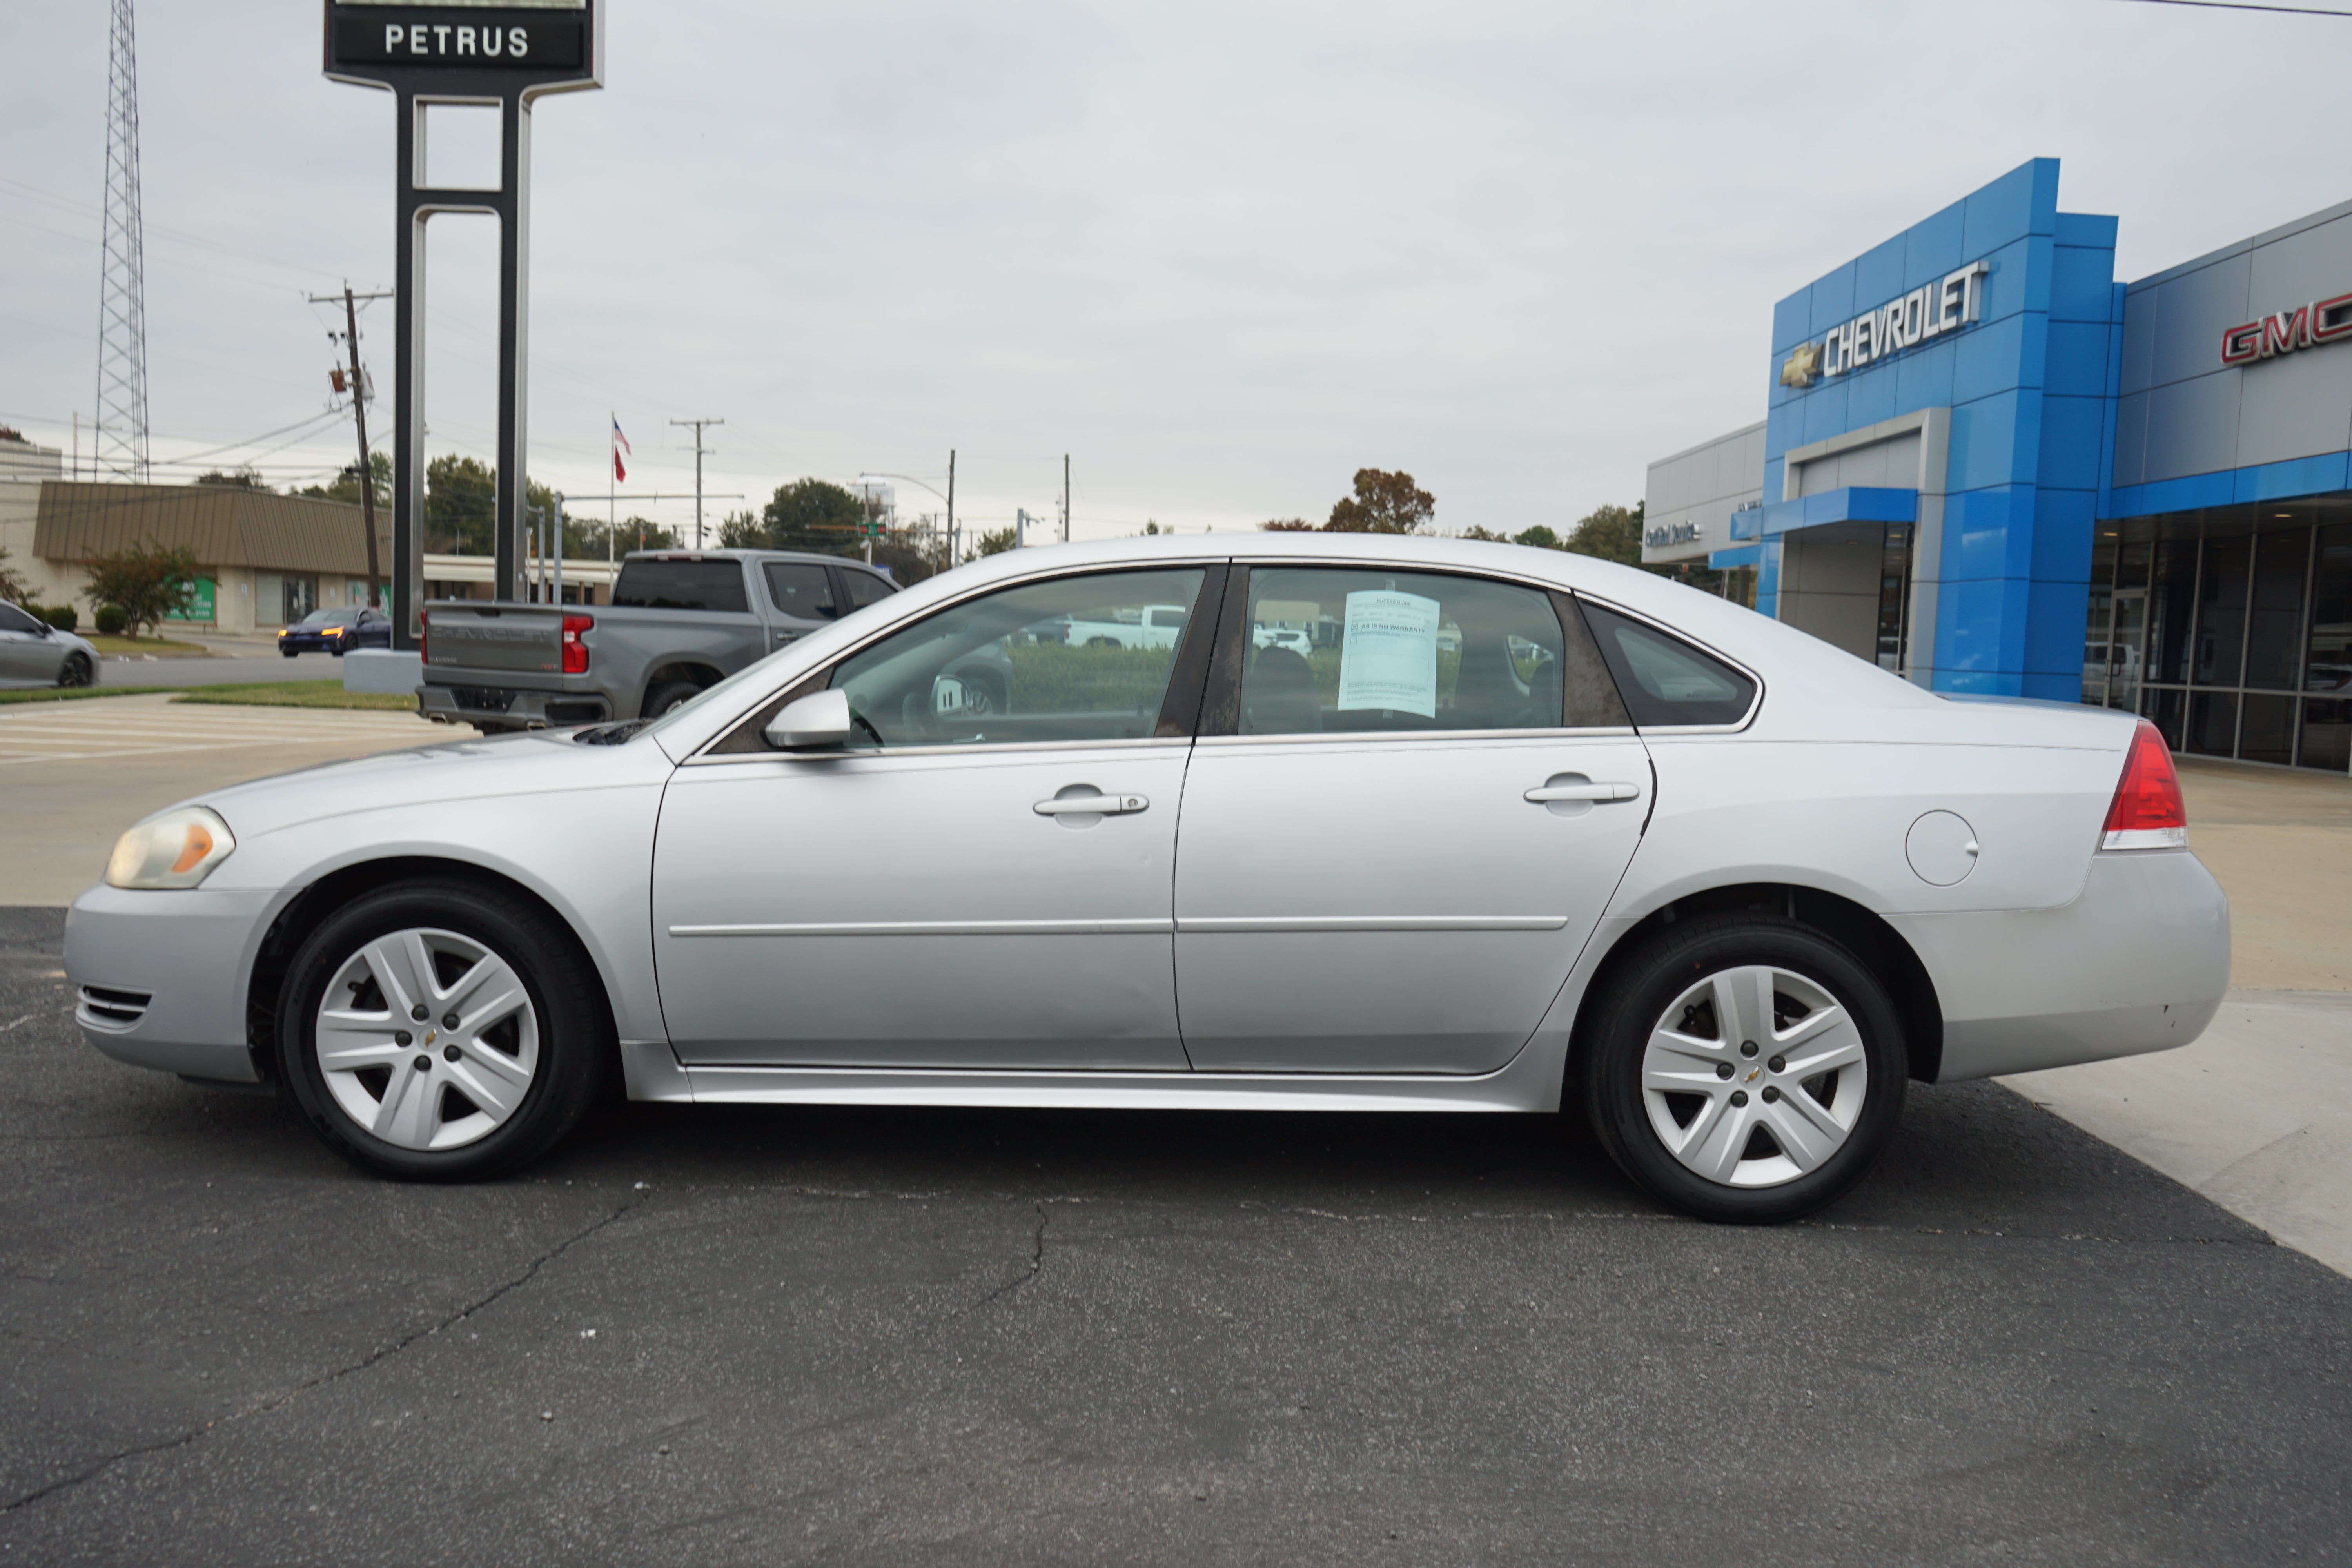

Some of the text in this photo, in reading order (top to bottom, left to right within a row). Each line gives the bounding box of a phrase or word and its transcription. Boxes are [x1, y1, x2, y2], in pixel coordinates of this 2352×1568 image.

[386, 24, 528, 58] PETRUS
[1823, 261, 1989, 377] CHEVROLET
[2220, 292, 2352, 367] GMC
[1390, 625, 1425, 635] WARRANTY
